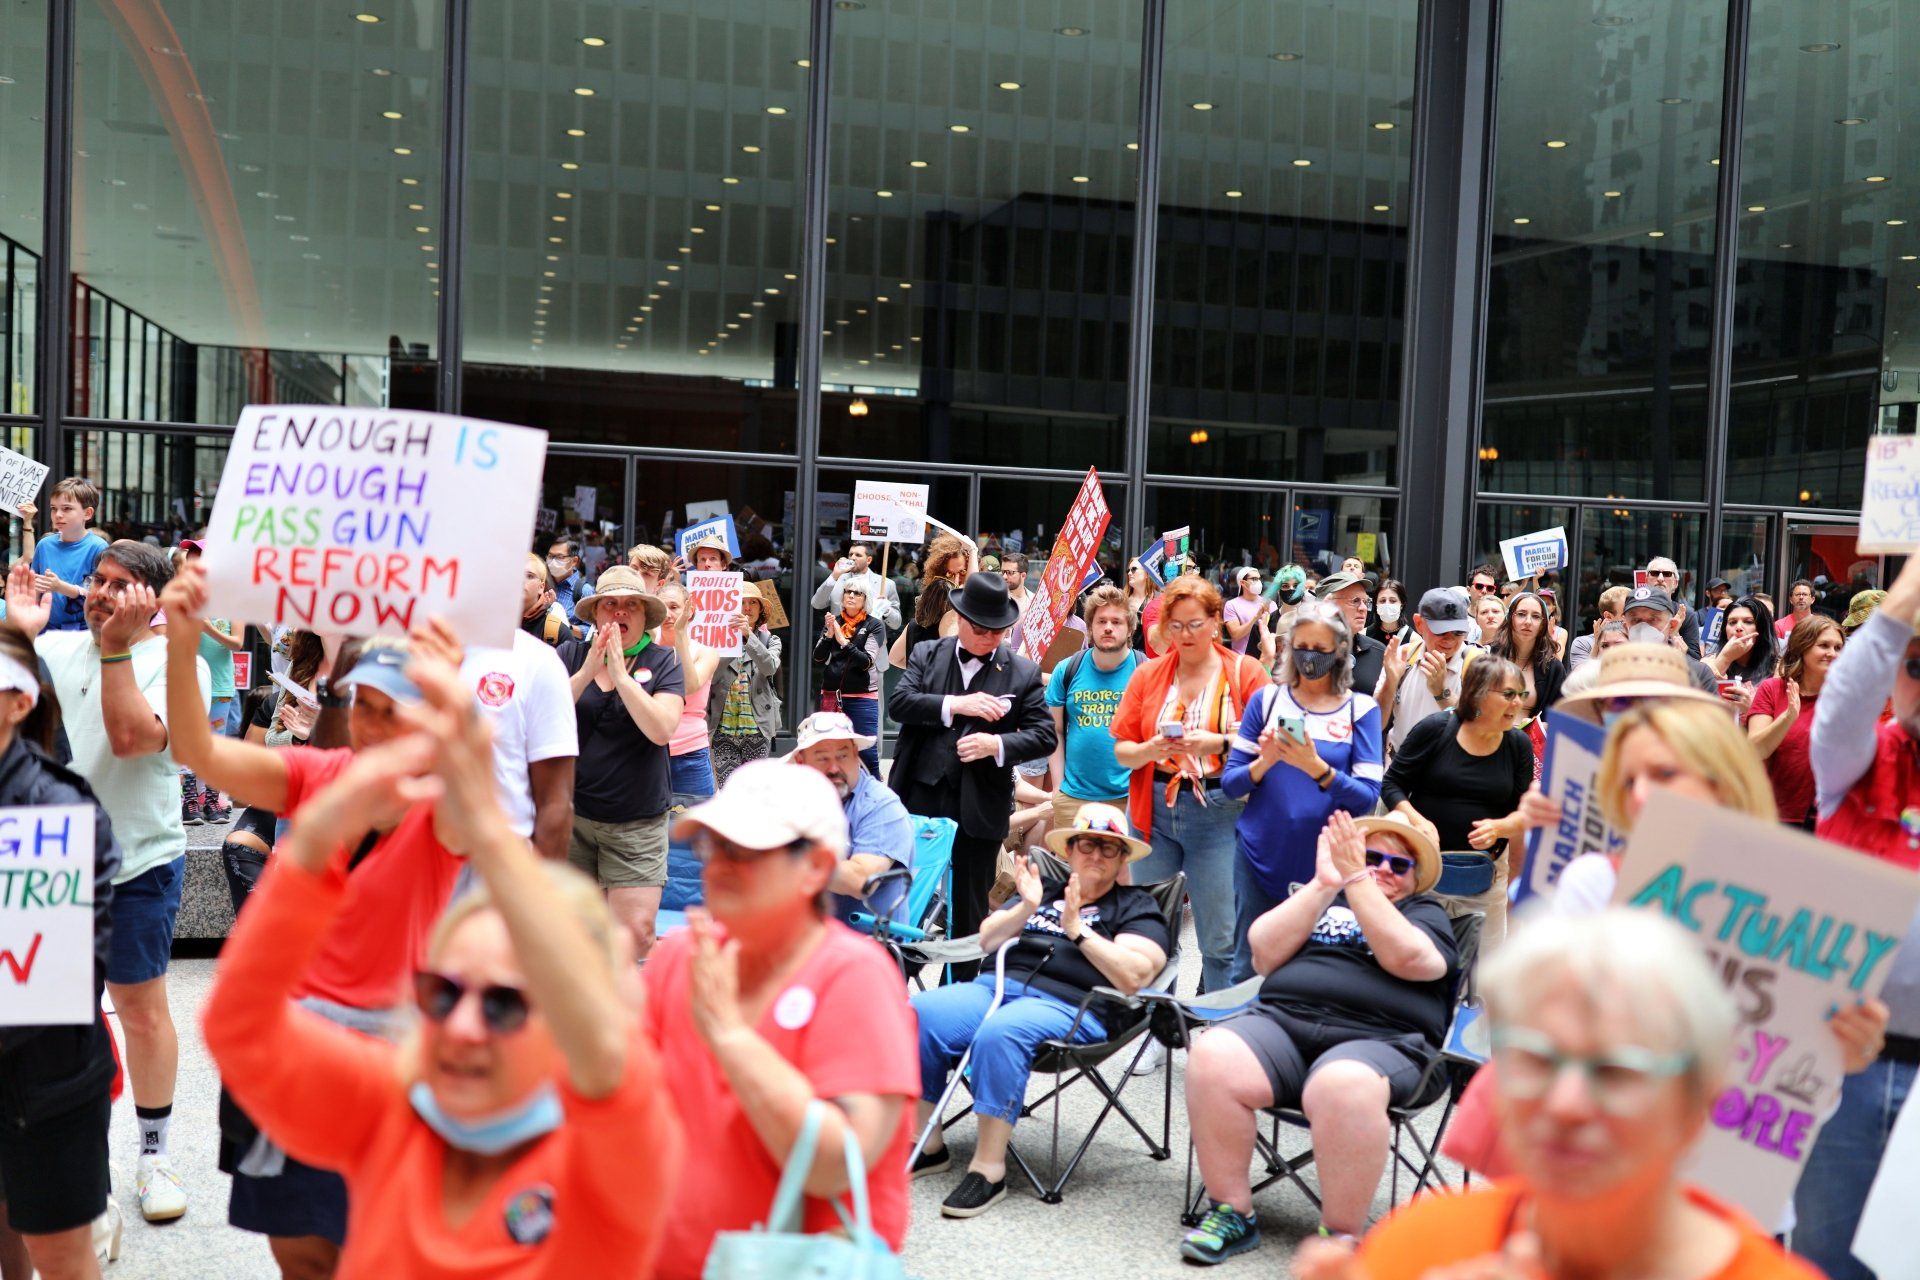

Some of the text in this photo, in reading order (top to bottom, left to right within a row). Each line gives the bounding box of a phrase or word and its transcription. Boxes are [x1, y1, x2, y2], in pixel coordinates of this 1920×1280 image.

[253, 414, 500, 471] ENOUGH IS
[6, 458, 44, 484] OF WAR
[1, 471, 38, 498] PLACE
[243, 462, 428, 507] ENOUGH
[857, 492, 892, 502] CHOOSE
[232, 504, 431, 549] PASS GUN
[685, 526, 716, 544] MARCH
[1525, 546, 1552, 556] MARCH
[1526, 552, 1557, 563] FOR OUR
[253, 546, 460, 599] REFORM
[692, 576, 738, 588] PROTECT
[275, 586, 417, 631] NOW
[689, 589, 740, 612] KIDS
[703, 613, 725, 624] NOT
[690, 624, 739, 649] GUNS
[1077, 715, 1114, 728] YOUT
[1628, 863, 1898, 992] ACTUALLY
[1711, 1086, 1816, 1162] ORE
